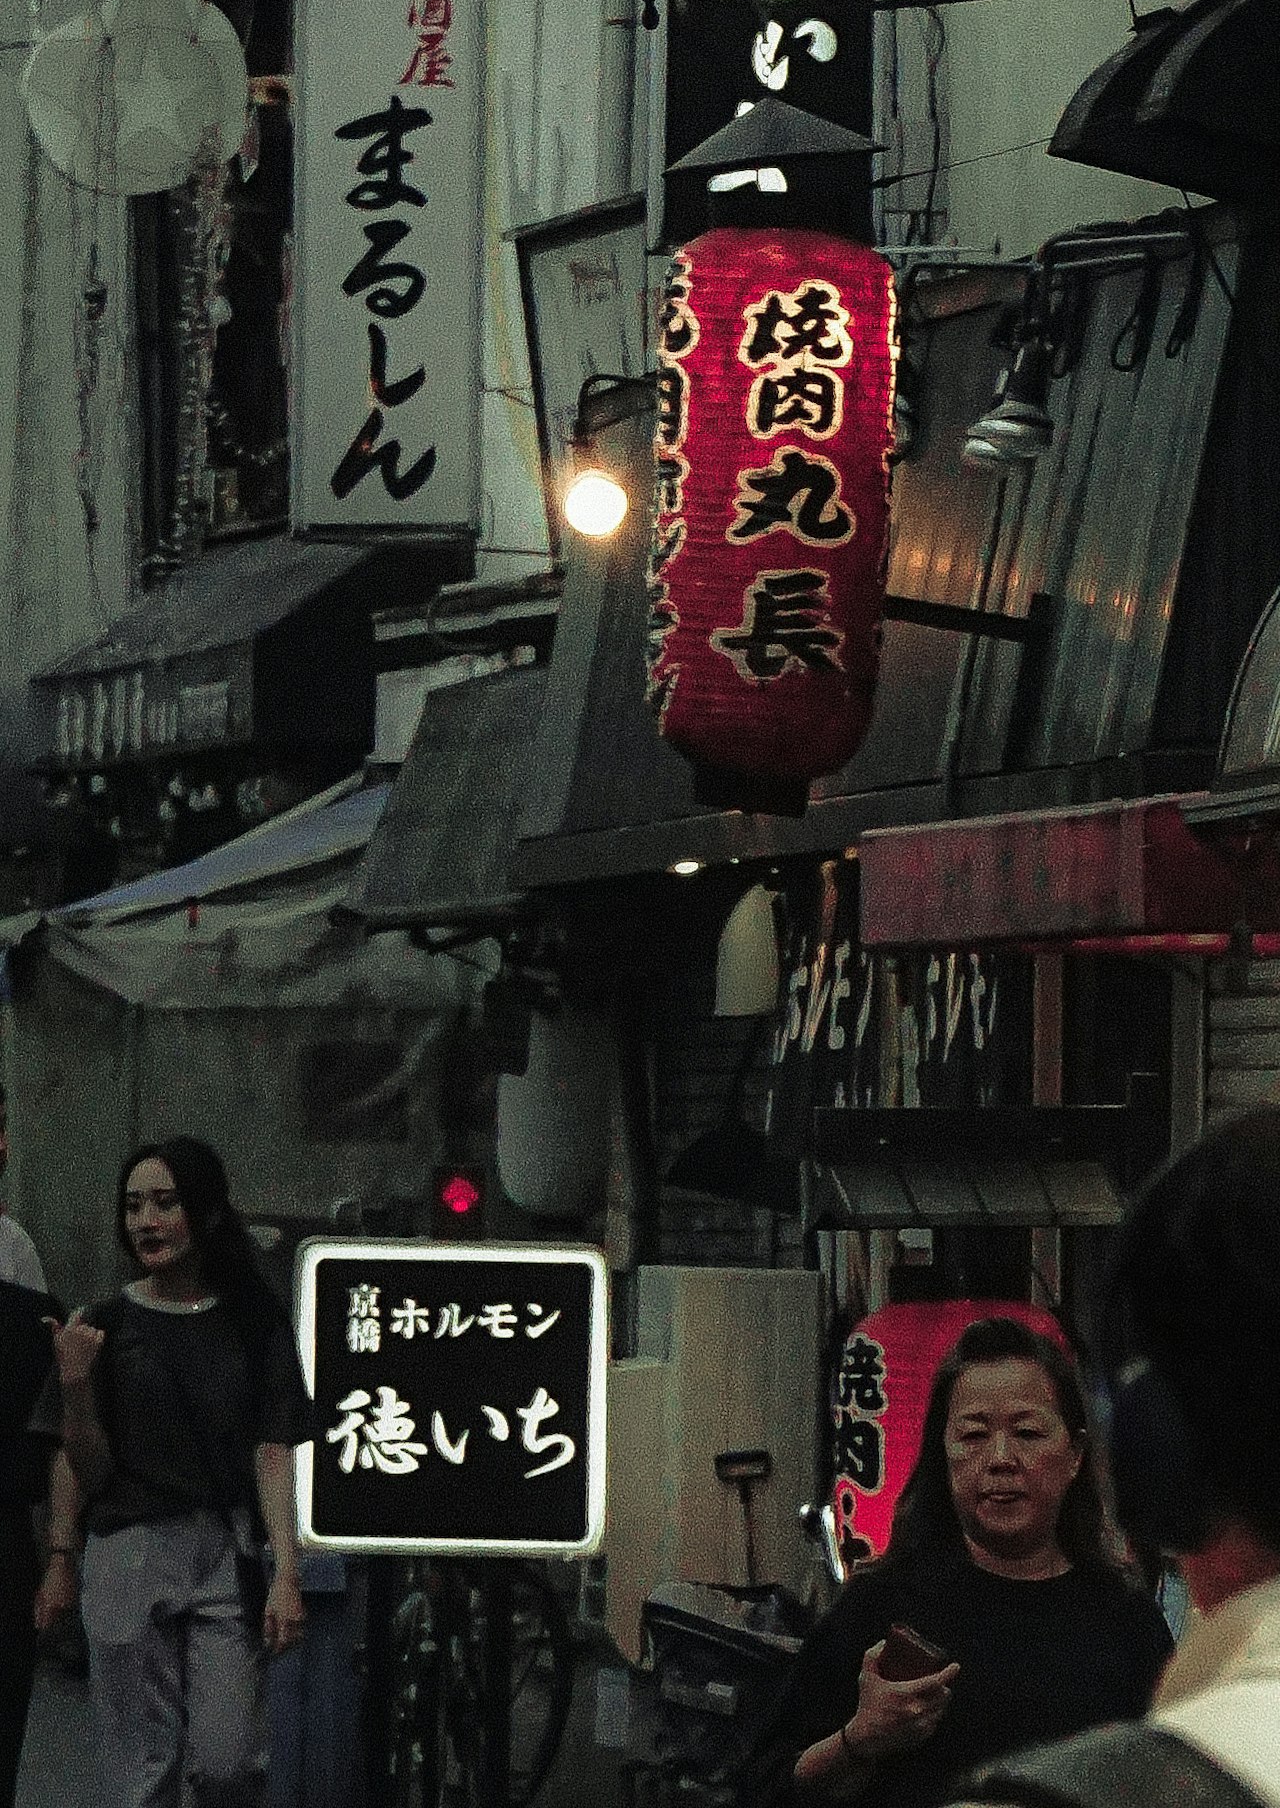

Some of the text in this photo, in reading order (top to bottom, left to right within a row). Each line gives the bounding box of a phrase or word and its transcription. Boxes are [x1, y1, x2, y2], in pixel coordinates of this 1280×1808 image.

[330, 96, 437, 501] まるしん
[709, 279, 858, 683] 焼肉丸長
[326, 1386, 577, 1479] 徳いち
[347, 1283, 562, 1354] 京橋 ホルモン
